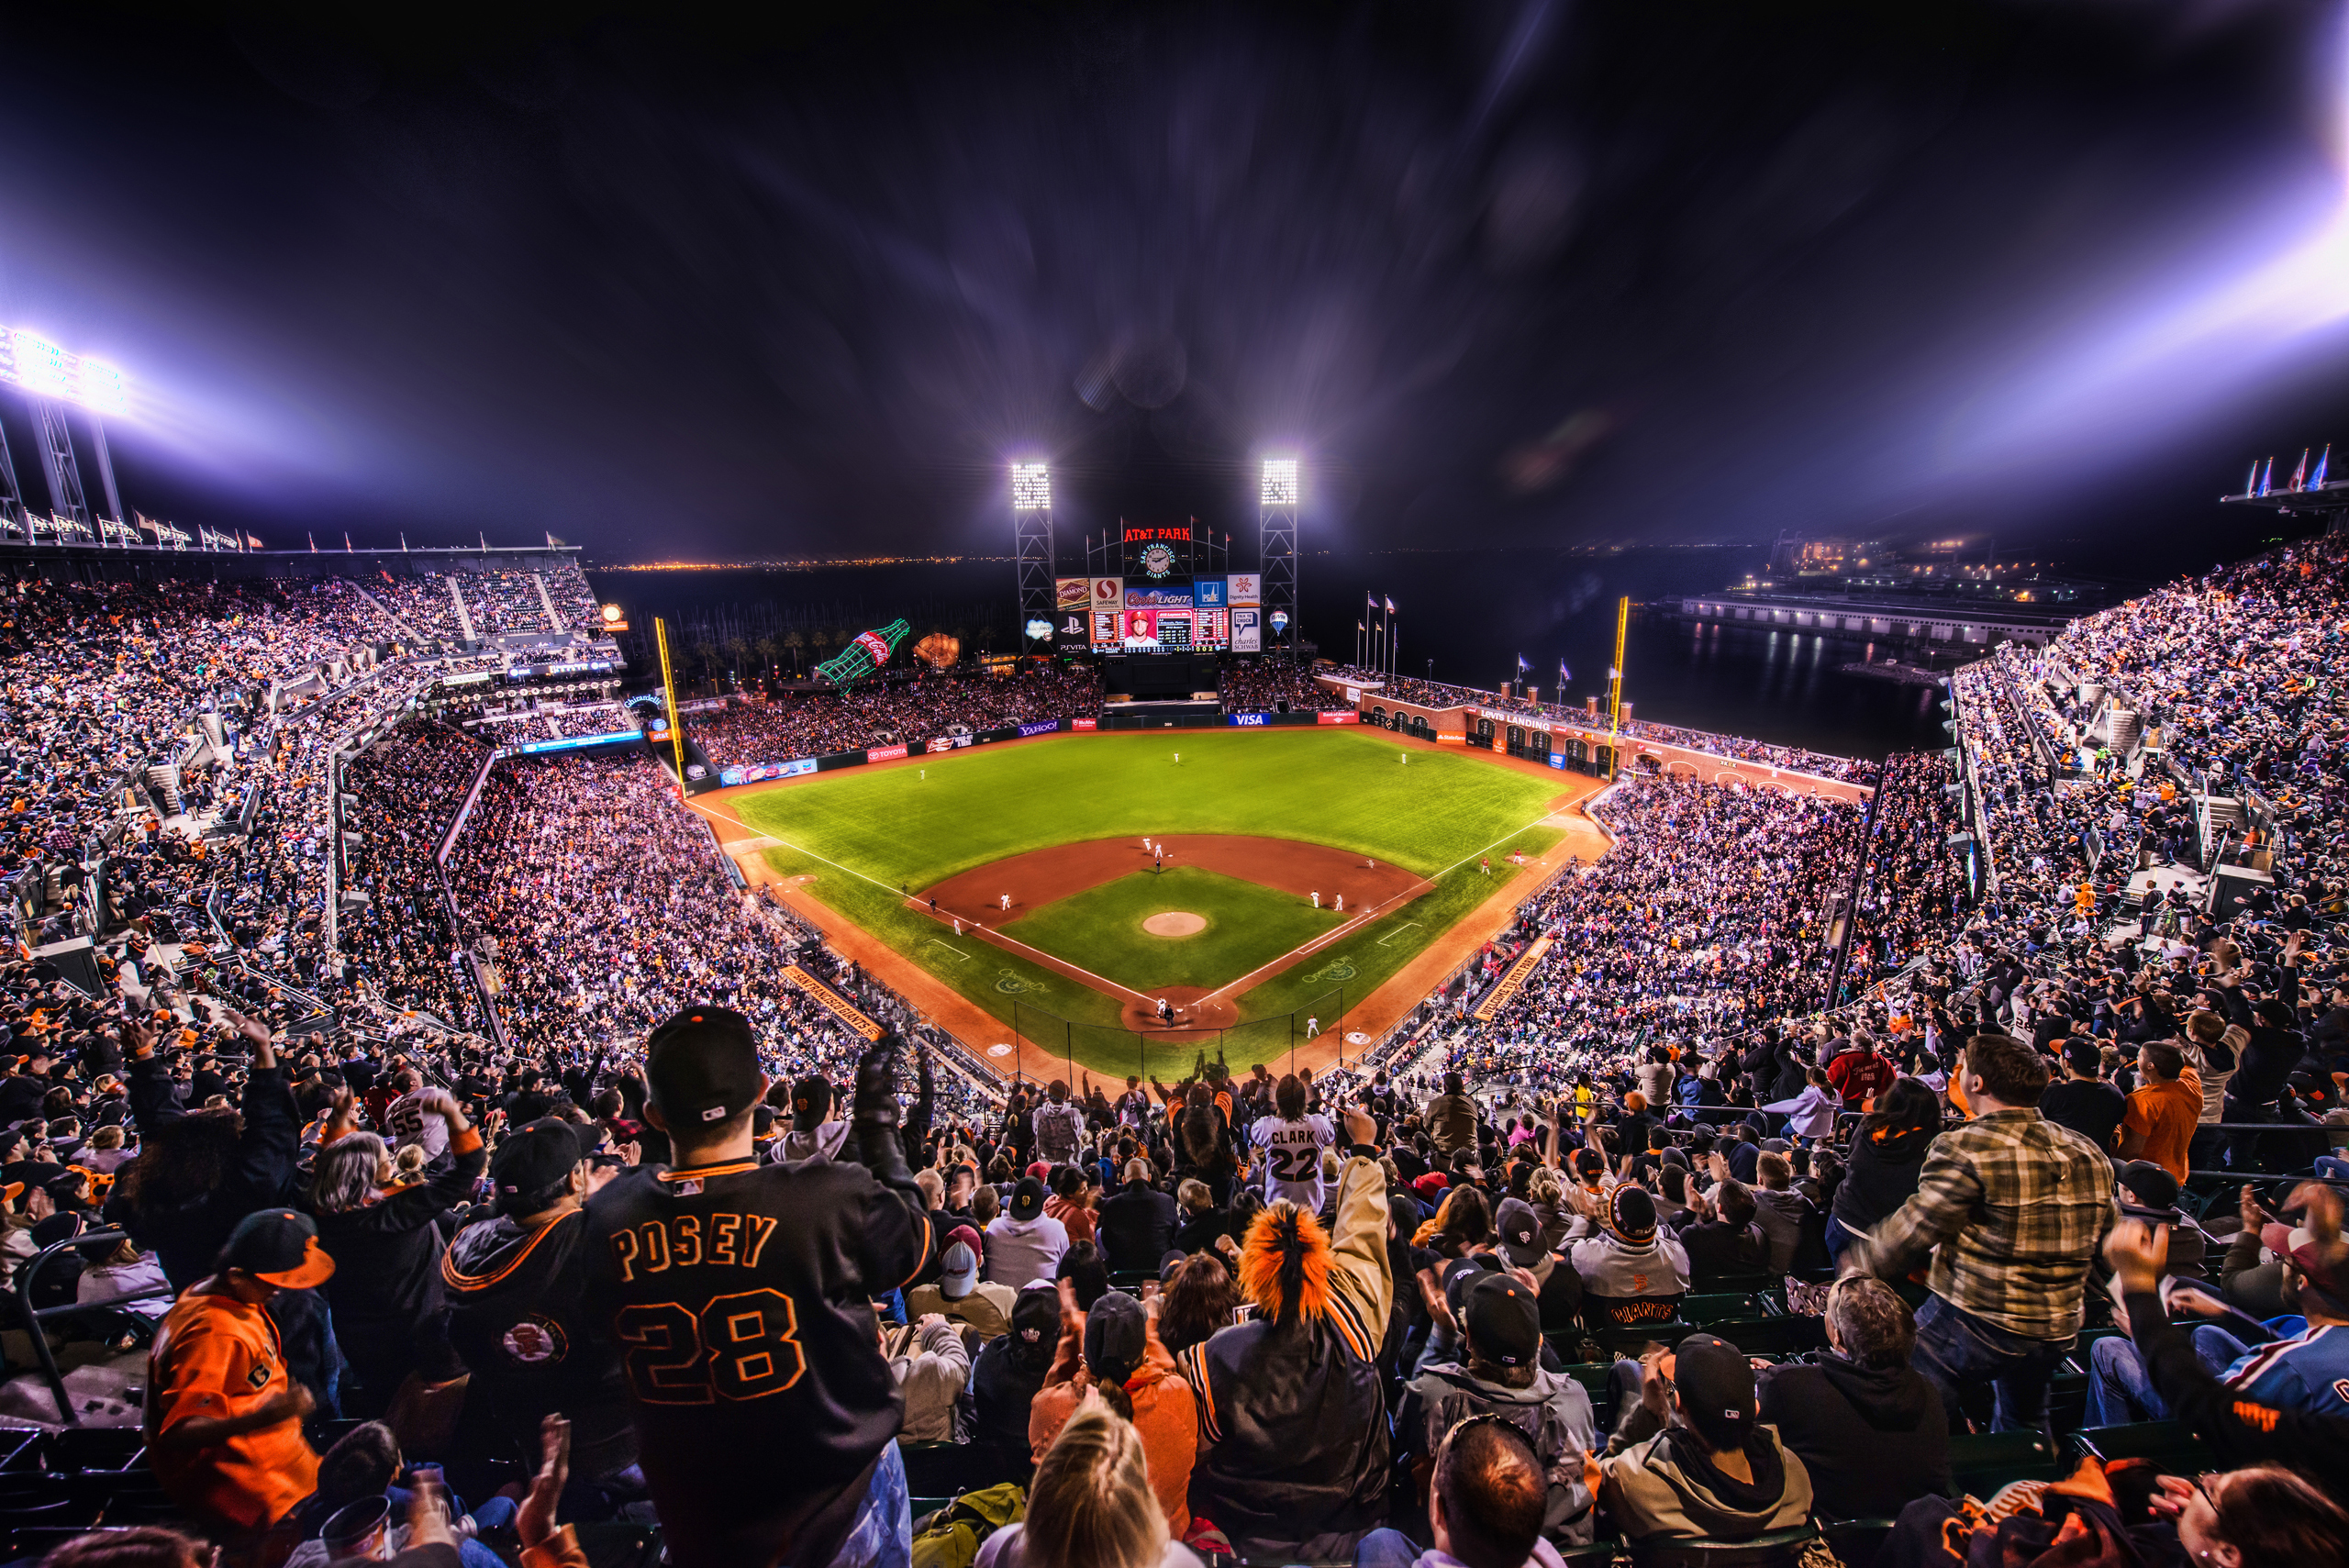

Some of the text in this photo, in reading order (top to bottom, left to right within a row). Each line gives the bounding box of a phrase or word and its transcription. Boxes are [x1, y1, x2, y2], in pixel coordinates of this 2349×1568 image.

[1124, 528, 1191, 542] AT&T PARK
[1140, 542, 1175, 564] SAN FRANCISCO
[1146, 569, 1171, 579] GIANTS
[1059, 586, 1087, 598] DIAMOND
[1127, 592, 1190, 606] Coors LIGHT
[1202, 594, 1219, 602] PG&E
[1234, 637, 1258, 645] charles
[624, 694, 662, 708] Ghirardelli
[1234, 715, 1264, 725] VISA
[1507, 715, 1551, 731] LANDING
[653, 731, 669, 740] at&t
[1019, 721, 1058, 737] YAHOO!
[879, 748, 907, 758] TOYOTA
[1480, 956, 1538, 1016] WELCOME TO AT&T PARK
[793, 973, 871, 1029] SAN FRANCISCO GIANTS
[2015, 1017, 2033, 1033] 28
[392, 1108, 425, 1137] 55
[1271, 1130, 1316, 1145] CLARK
[1269, 1147, 1319, 1183] 22
[609, 1212, 778, 1283] POSEY
[1610, 1300, 1674, 1325] GIANTS
[616, 1286, 808, 1406] 28
